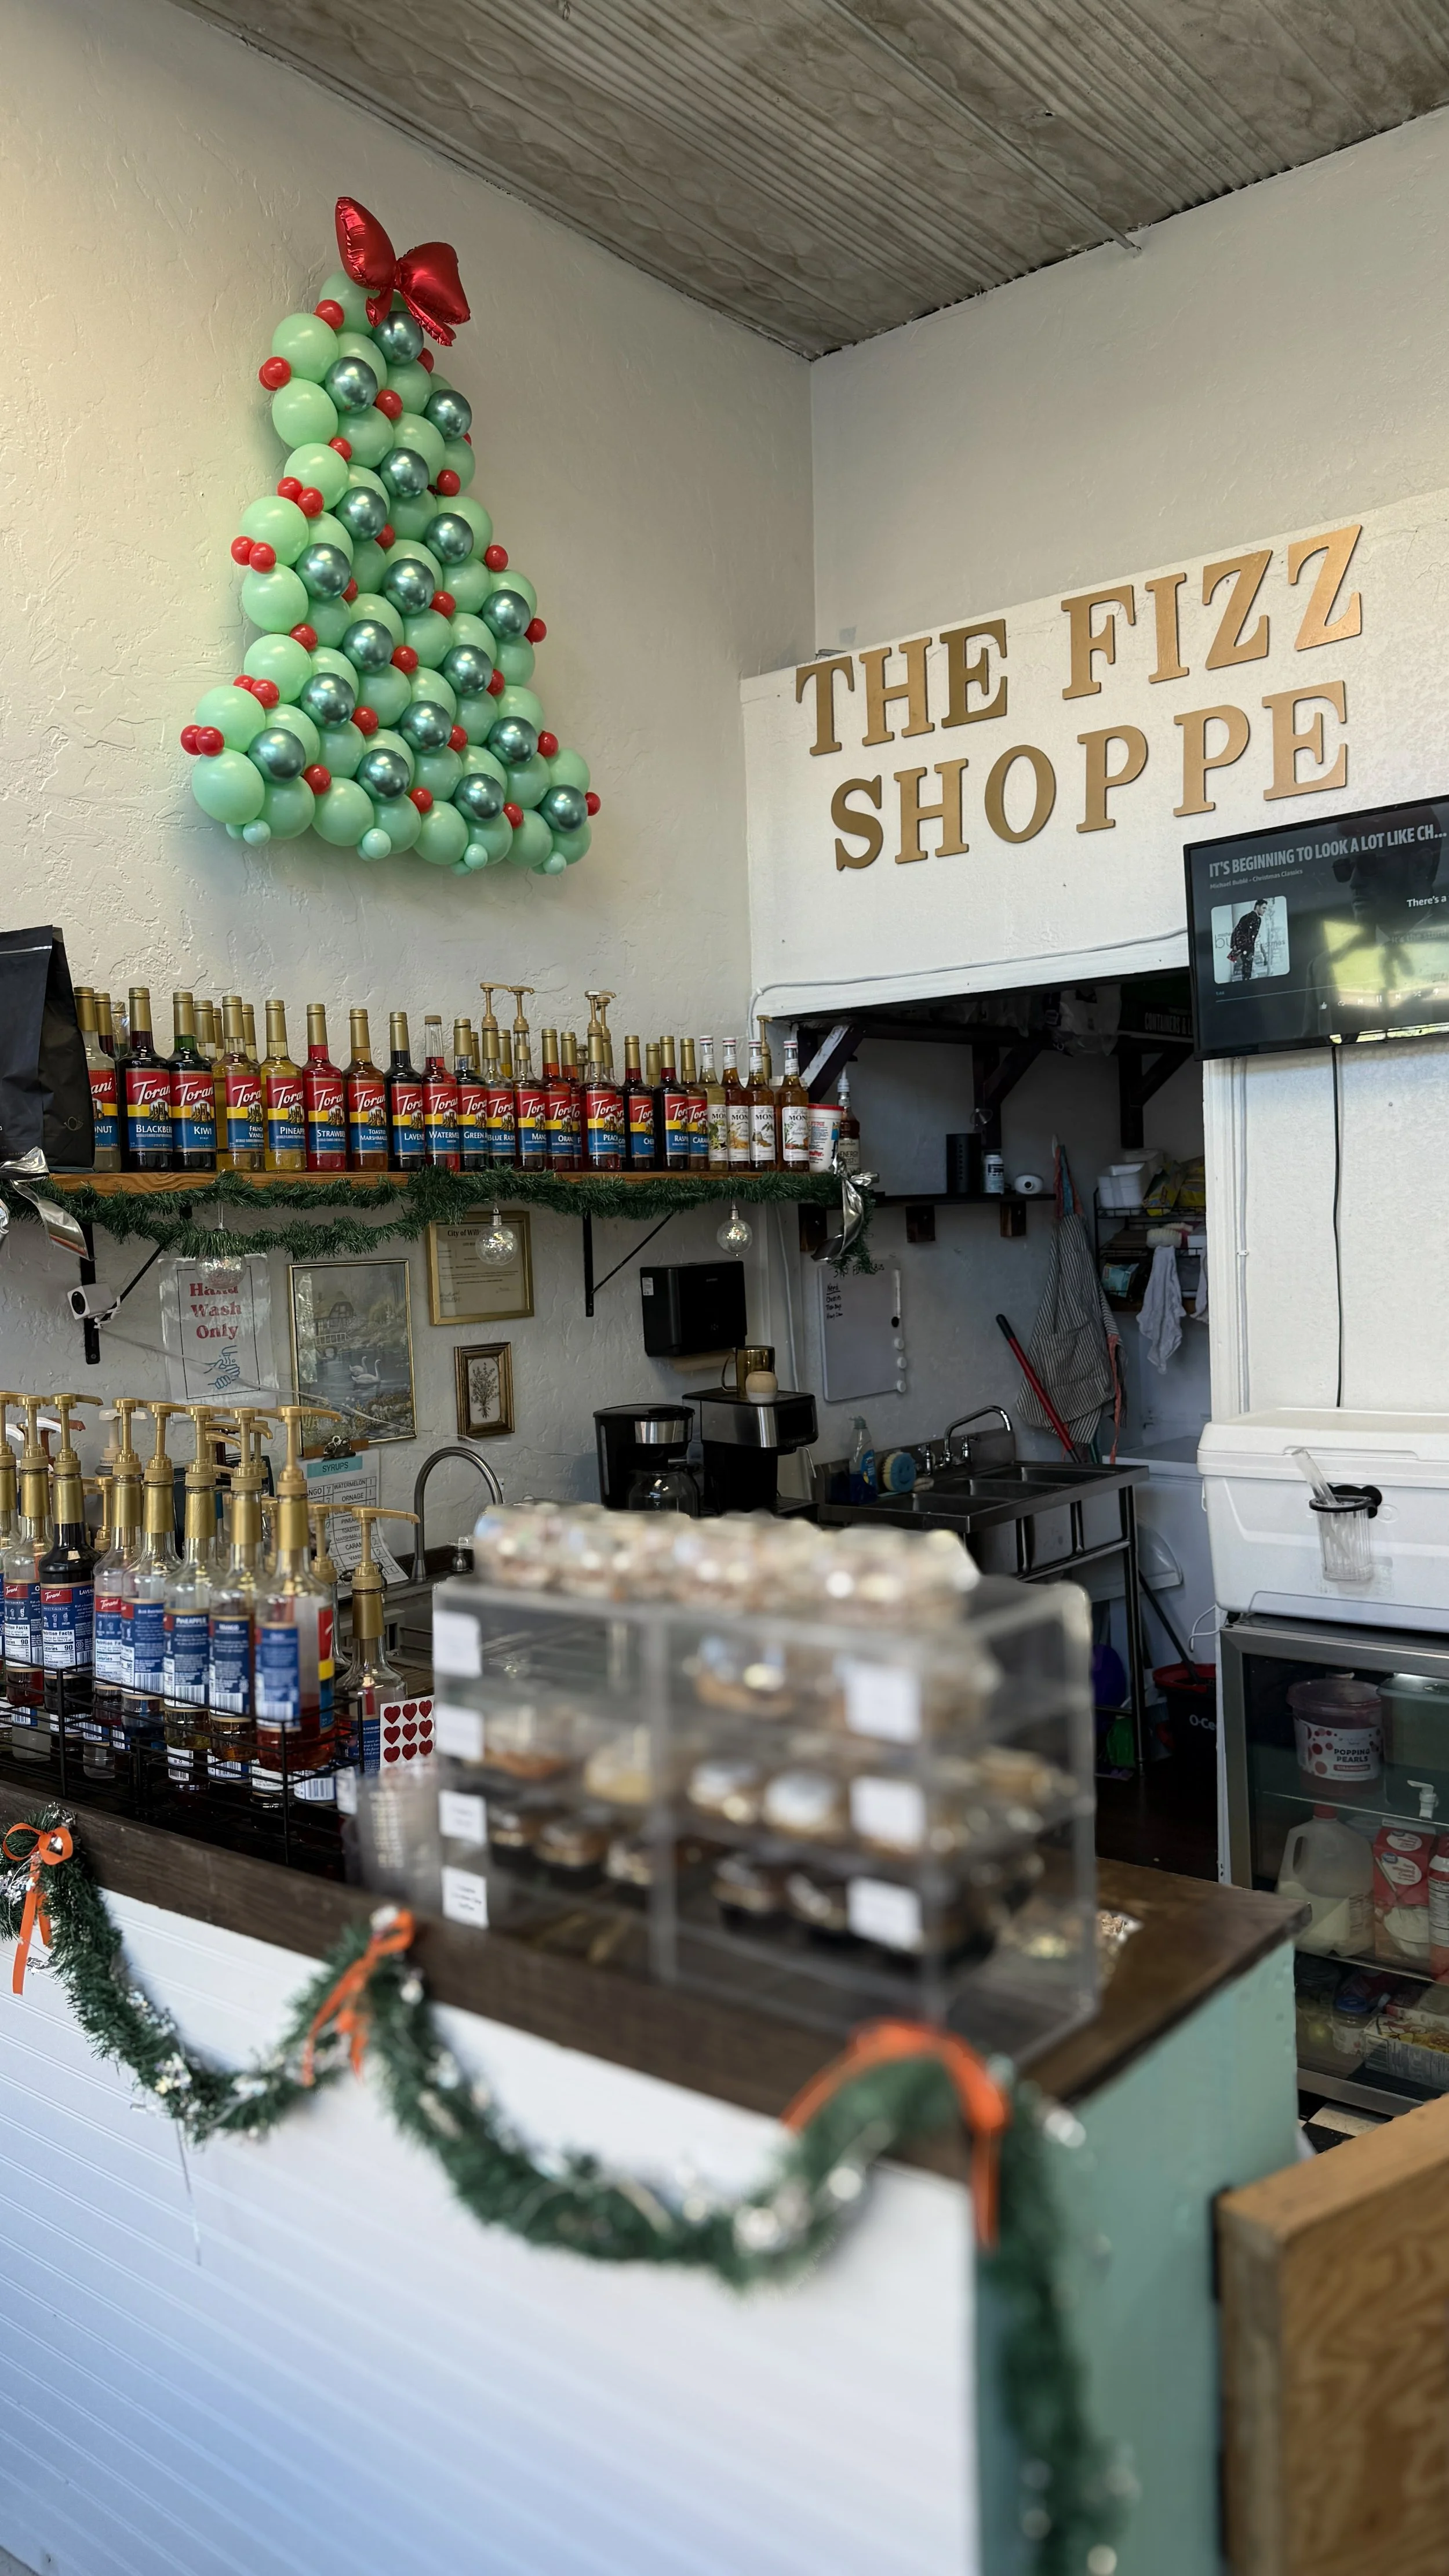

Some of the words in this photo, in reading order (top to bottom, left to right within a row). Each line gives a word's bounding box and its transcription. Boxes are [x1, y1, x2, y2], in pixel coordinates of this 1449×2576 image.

[796, 618, 1007, 756] THE
[1061, 524, 1362, 700] FIZZ
[831, 680, 1348, 871] SHOPPE
[1209, 860, 1230, 878] IT'S
[1232, 849, 1294, 874] BEGINNING
[1296, 846, 1313, 862] TO
[1315, 839, 1349, 859] LOOK
[1350, 838, 1359, 853] A
[1361, 833, 1385, 851] LOT
[1387, 828, 1415, 846] LIKE
[1210, 881, 1231, 889] Michael
[1253, 873, 1280, 882] Christmas
[1281, 869, 1303, 877] Classics
[1406, 896, 1440, 907] There's
[90, 1077, 112, 1095] ani
[133, 1079, 171, 1107] Toran
[175, 1080, 214, 1108] Toran
[232, 1082, 263, 1109] Tora
[354, 1089, 386, 1114] Toran
[397, 1093, 423, 1117] Tora
[463, 1094, 487, 1116] Tora
[489, 1097, 514, 1119] Tora
[522, 1097, 545, 1119] Tora
[549, 1100, 572, 1122] Tora
[592, 1098, 617, 1120] Tora
[194, 1126, 212, 1135] KIWI
[447, 1229, 460, 1239] City
[190, 1301, 242, 1318] Wash
[196, 1323, 239, 1340] Only
[322, 1462, 349, 1473] SYRUPS
[307, 1487, 322, 1497] NGO
[334, 1479, 366, 1490] WATERMELON
[342, 1492, 365, 1502] ORNAGE
[335, 1534, 361, 1542] MARSHMALL
[45, 1591, 61, 1602] Torani
[100, 1599, 119, 1610] Torani
[1189, 1714, 1215, 1731] O-Ce
